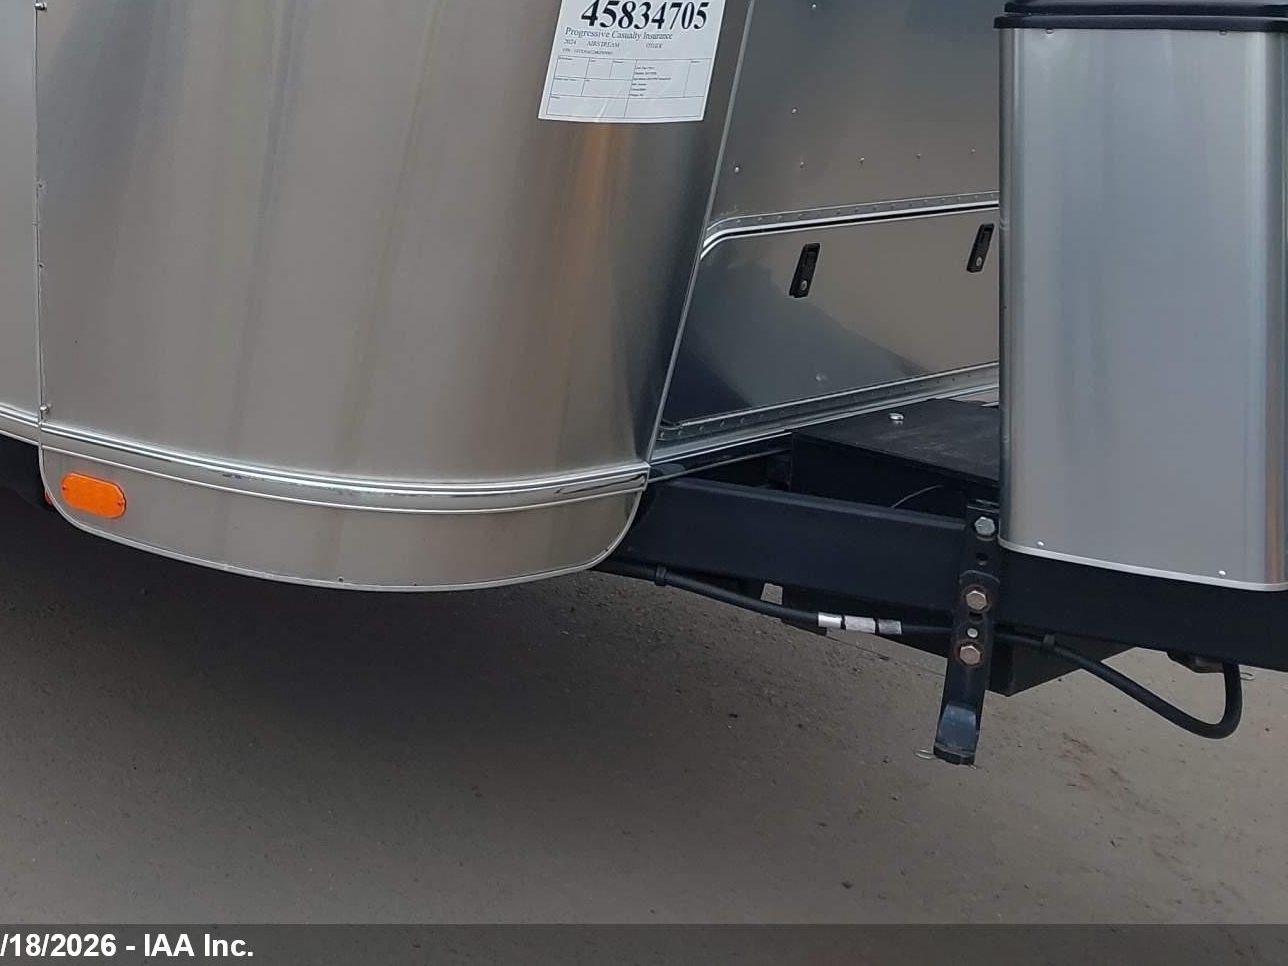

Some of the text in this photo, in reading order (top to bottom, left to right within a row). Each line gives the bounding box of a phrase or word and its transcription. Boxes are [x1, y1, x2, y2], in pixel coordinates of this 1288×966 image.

[565, 26, 673, 41] Progressive Casualty Insurance
[587, 40, 620, 48] AIRSTREAM
